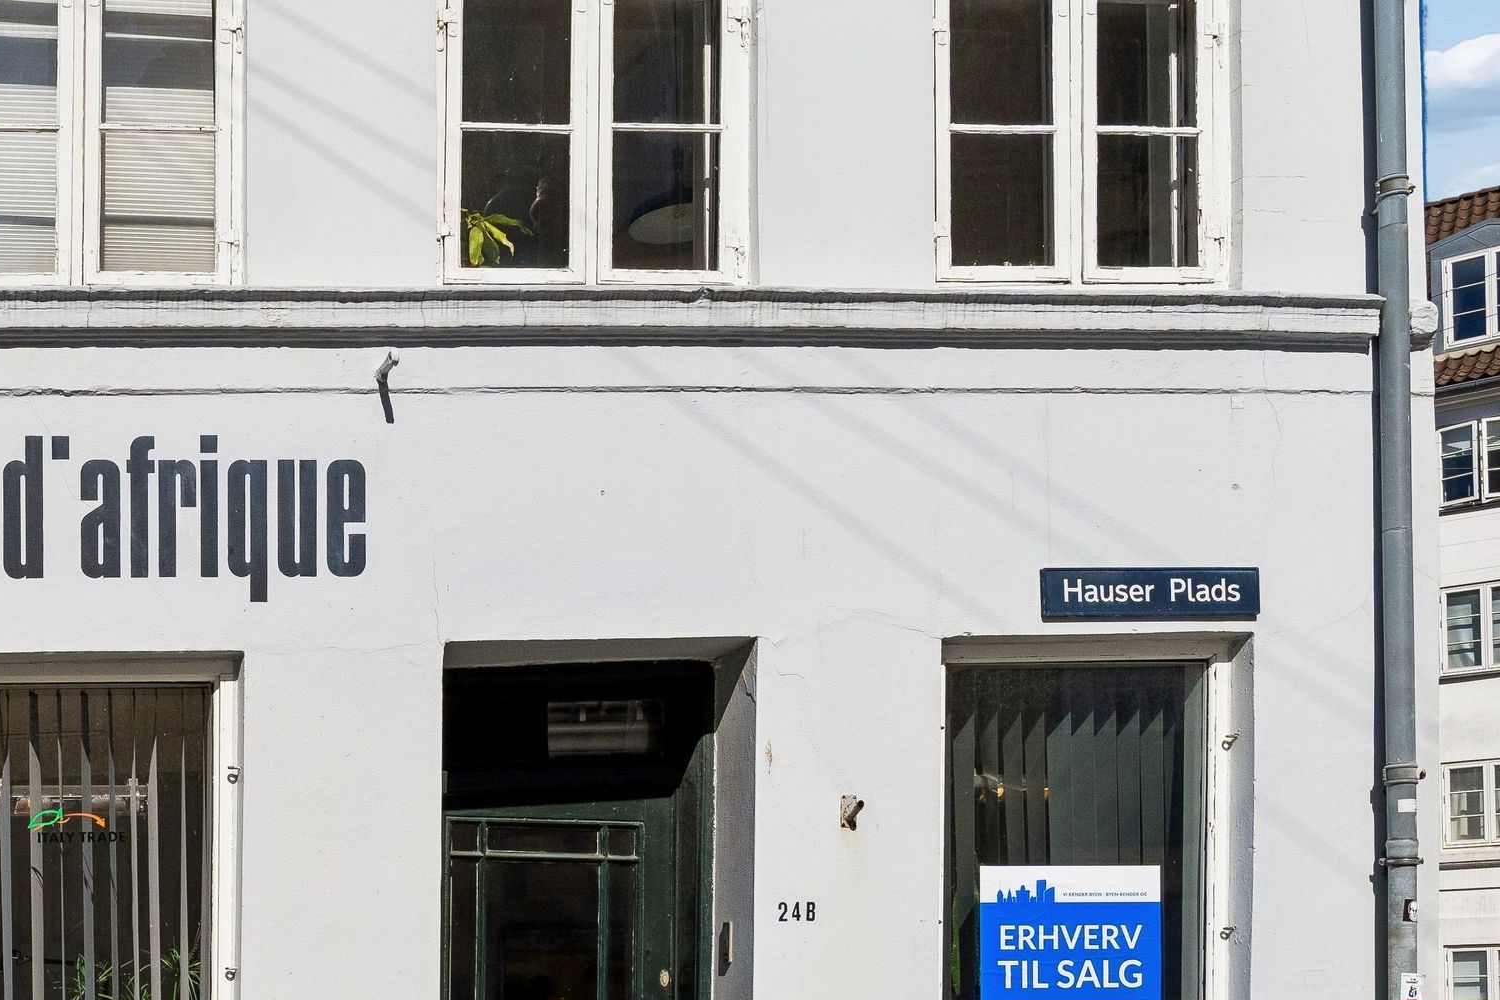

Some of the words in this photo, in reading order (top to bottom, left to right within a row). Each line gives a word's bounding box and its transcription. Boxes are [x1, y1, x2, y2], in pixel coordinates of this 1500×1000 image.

[3, 435, 366, 602] d'afrique
[1064, 579, 1154, 602] Hauser
[1170, 578, 1240, 602] Plads
[37, 832, 74, 843] ITALY
[79, 831, 126, 843] TRADE
[1001, 925, 1142, 950] ERHVERV
[998, 961, 1048, 988] TIL
[1057, 960, 1142, 988] SALG
